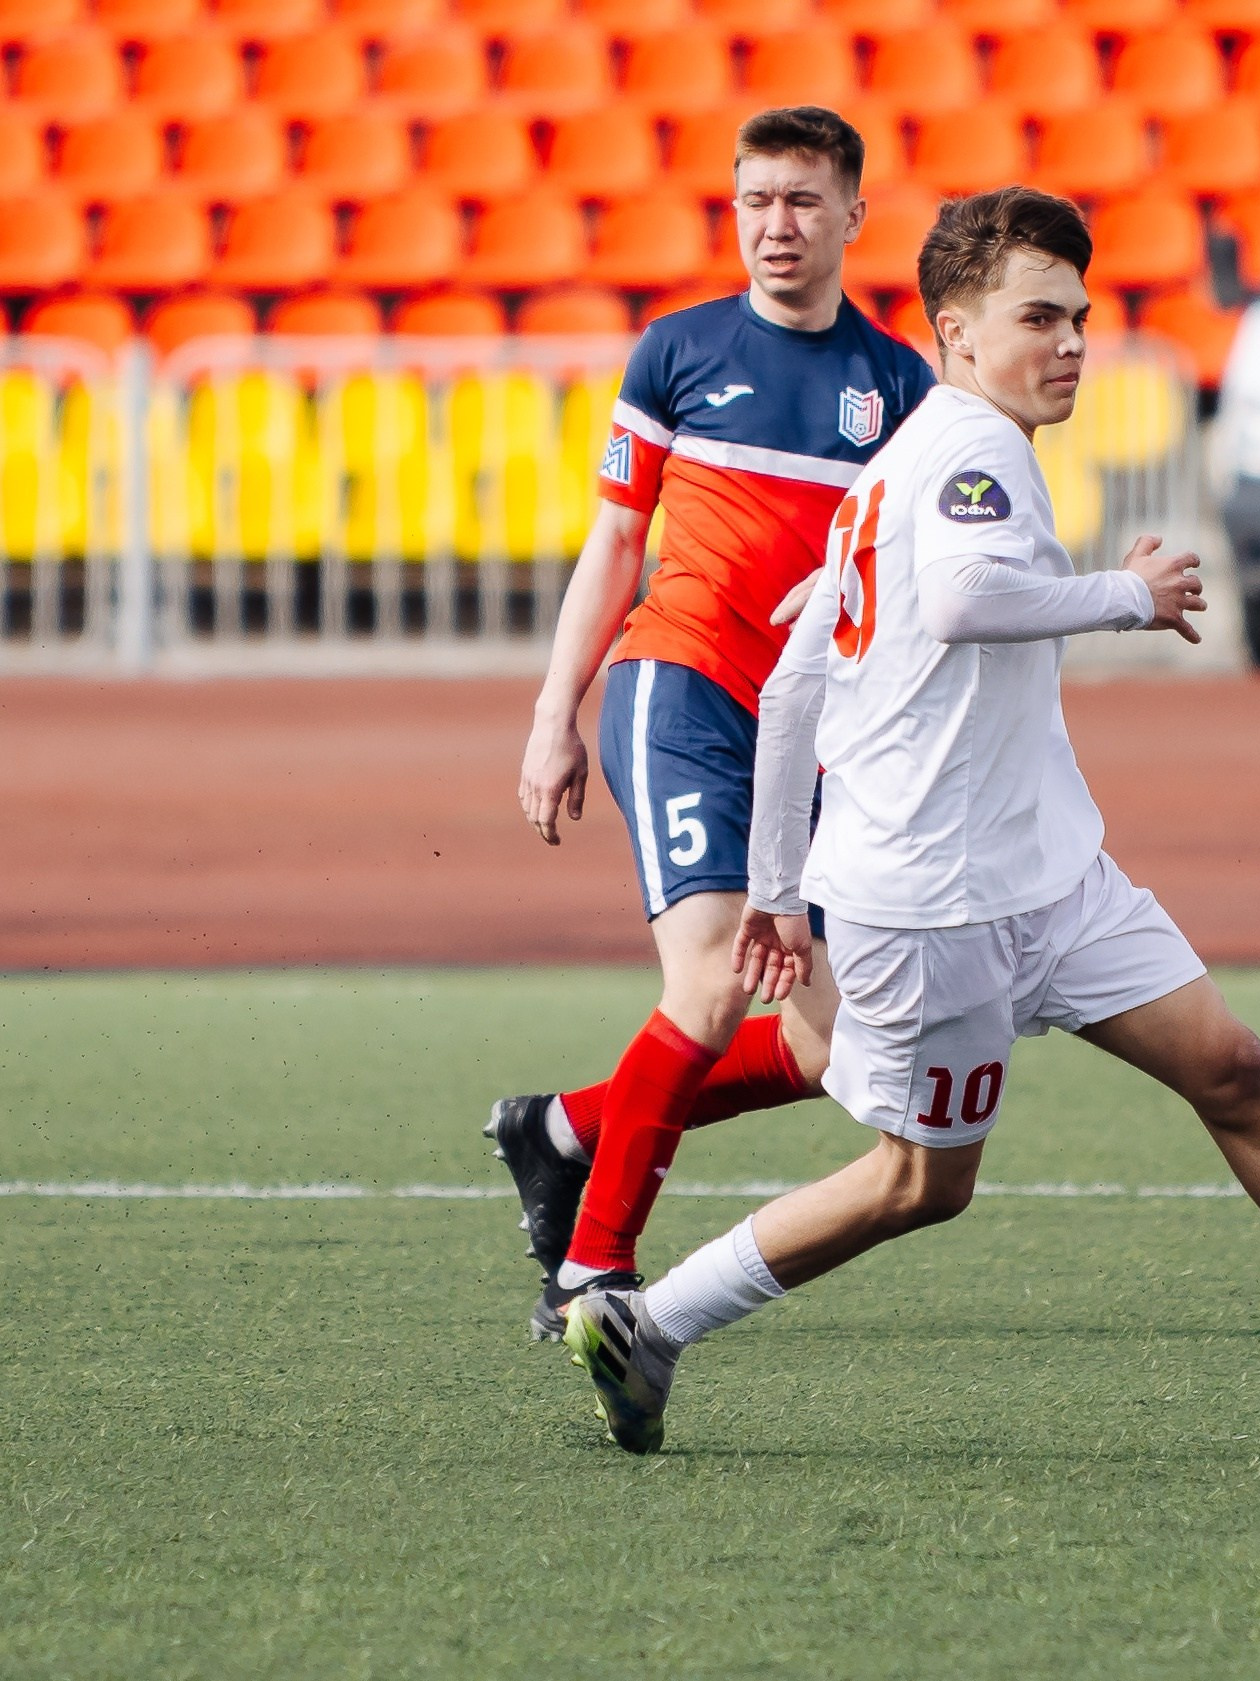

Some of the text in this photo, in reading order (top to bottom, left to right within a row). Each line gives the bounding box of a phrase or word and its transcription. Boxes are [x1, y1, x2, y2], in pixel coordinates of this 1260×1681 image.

[950, 504, 997, 516] ЮФЛ
[666, 791, 708, 866] 5
[916, 1061, 1004, 1129] 10
